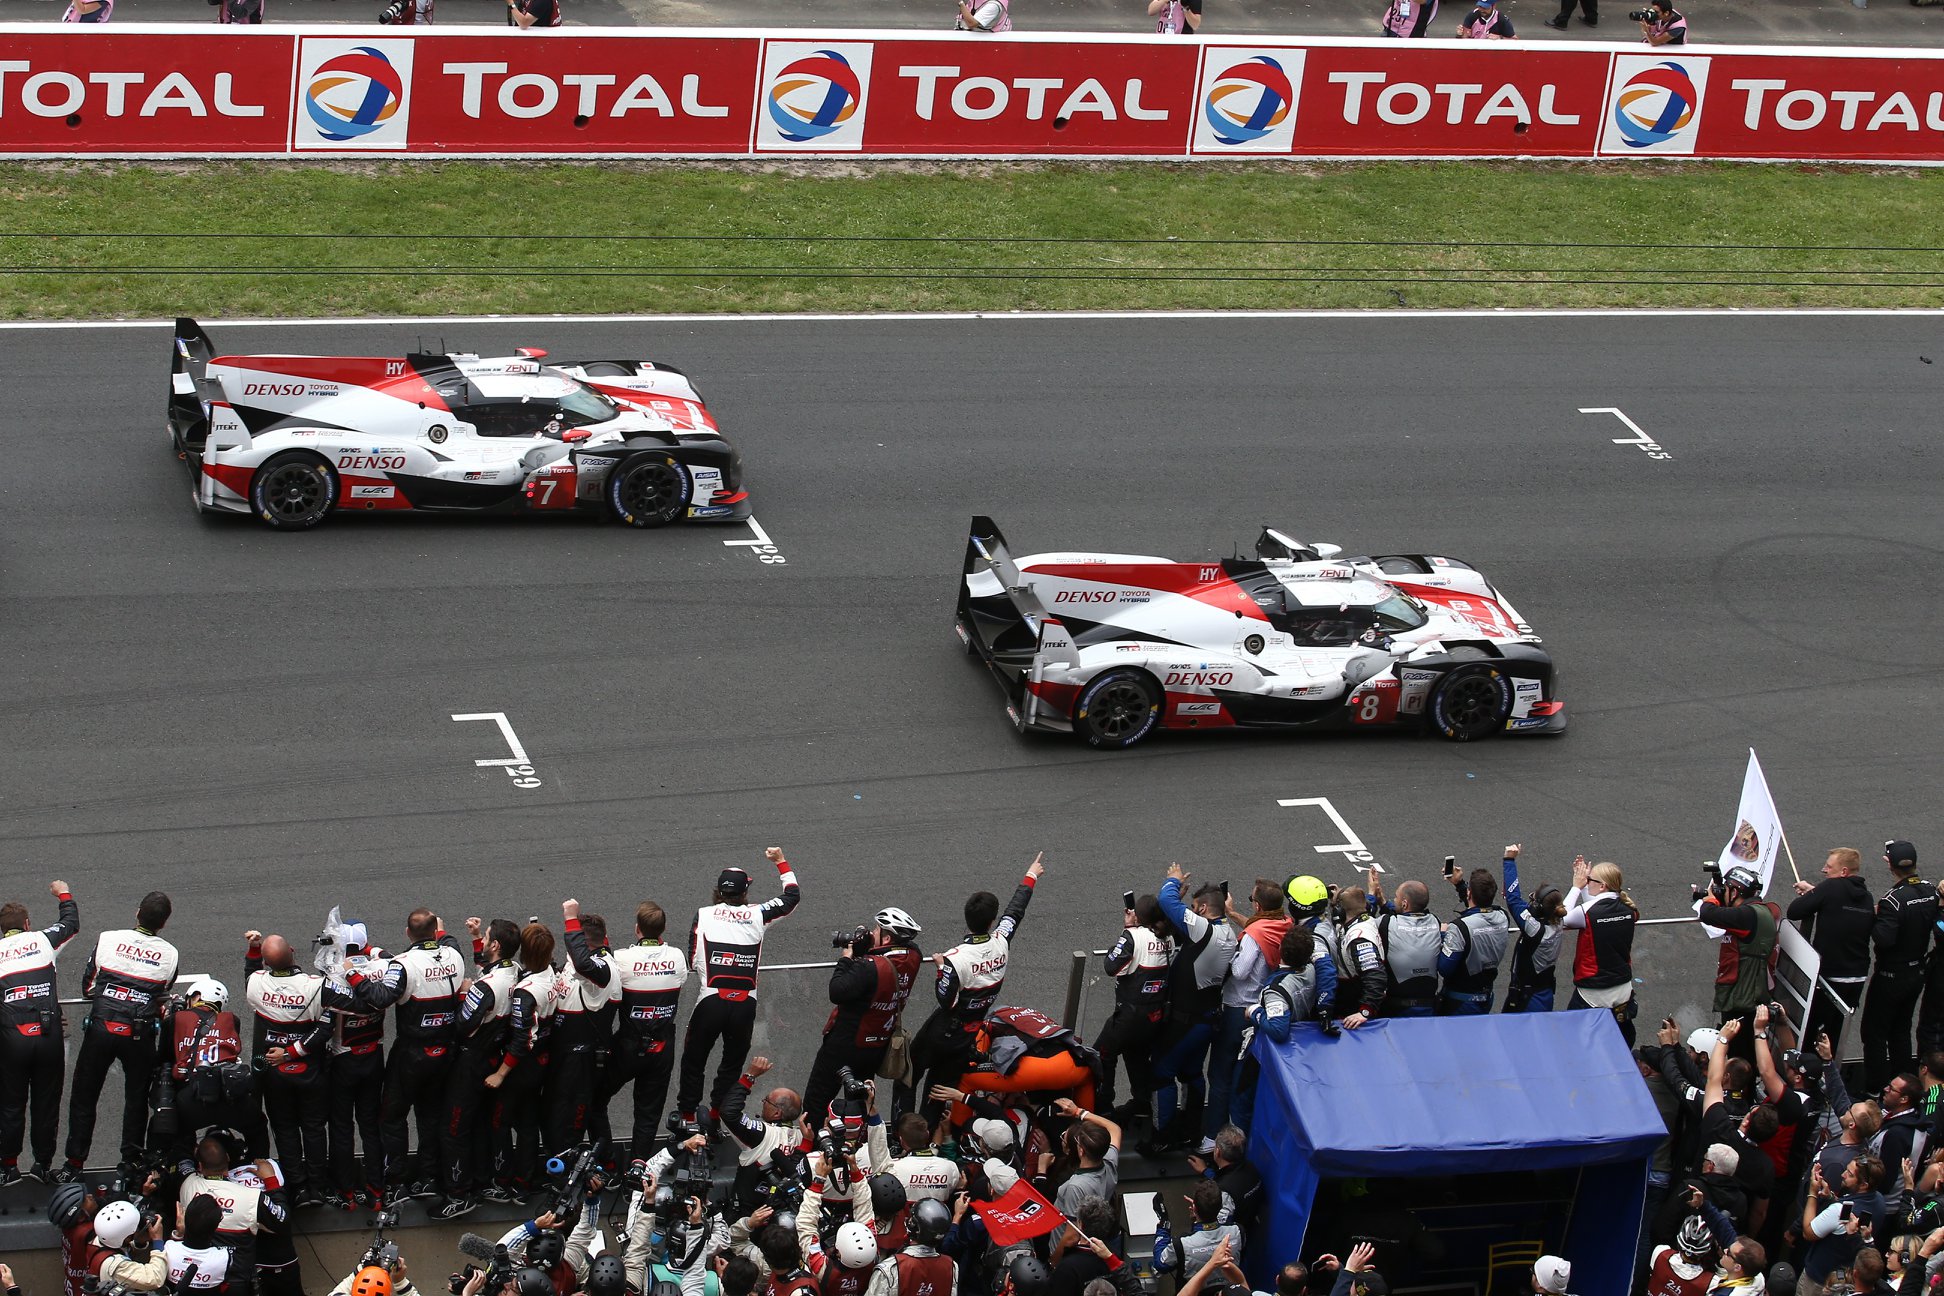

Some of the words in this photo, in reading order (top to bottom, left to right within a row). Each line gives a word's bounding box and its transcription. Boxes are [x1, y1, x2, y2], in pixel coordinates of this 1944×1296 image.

[442, 61, 729, 119] TOTAL
[898, 65, 1170, 122] TOTAL
[1327, 71, 1581, 126] TOTAL
[386, 361, 405, 376] HY
[505, 364, 534, 373] ZENT
[244, 384, 305, 396] DENSO
[1636, 443, 1674, 460] 25
[337, 456, 406, 469] DENSO
[540, 481, 557, 505] 7
[750, 545, 786, 564] 28
[1200, 568, 1219, 581] HY
[1319, 569, 1348, 578] ZENT
[1055, 591, 1117, 603] DENSO
[1044, 640, 1067, 648] JTEKT
[1164, 672, 1233, 686] DENSO
[1403, 672, 1437, 680] RAYS
[1360, 695, 1380, 720] 8
[504, 765, 542, 788] 29
[1342, 850, 1386, 873] 27
[713, 908, 752, 920] DENSO
[1596, 914, 1632, 923] PORSCHE
[116, 943, 162, 961] DENSO
[633, 960, 675, 971] DENSO
[711, 956, 734, 965] GR
[972, 954, 1007, 974] DENSO
[425, 963, 456, 978] DENSO
[5, 991, 27, 1002] GR
[103, 989, 129, 1001] GR
[262, 992, 305, 1005] DENSO
[631, 1010, 654, 1019] GR
[422, 1018, 443, 1027] GR
[909, 1174, 948, 1184] DENSO
[171, 1269, 211, 1283] DESO
